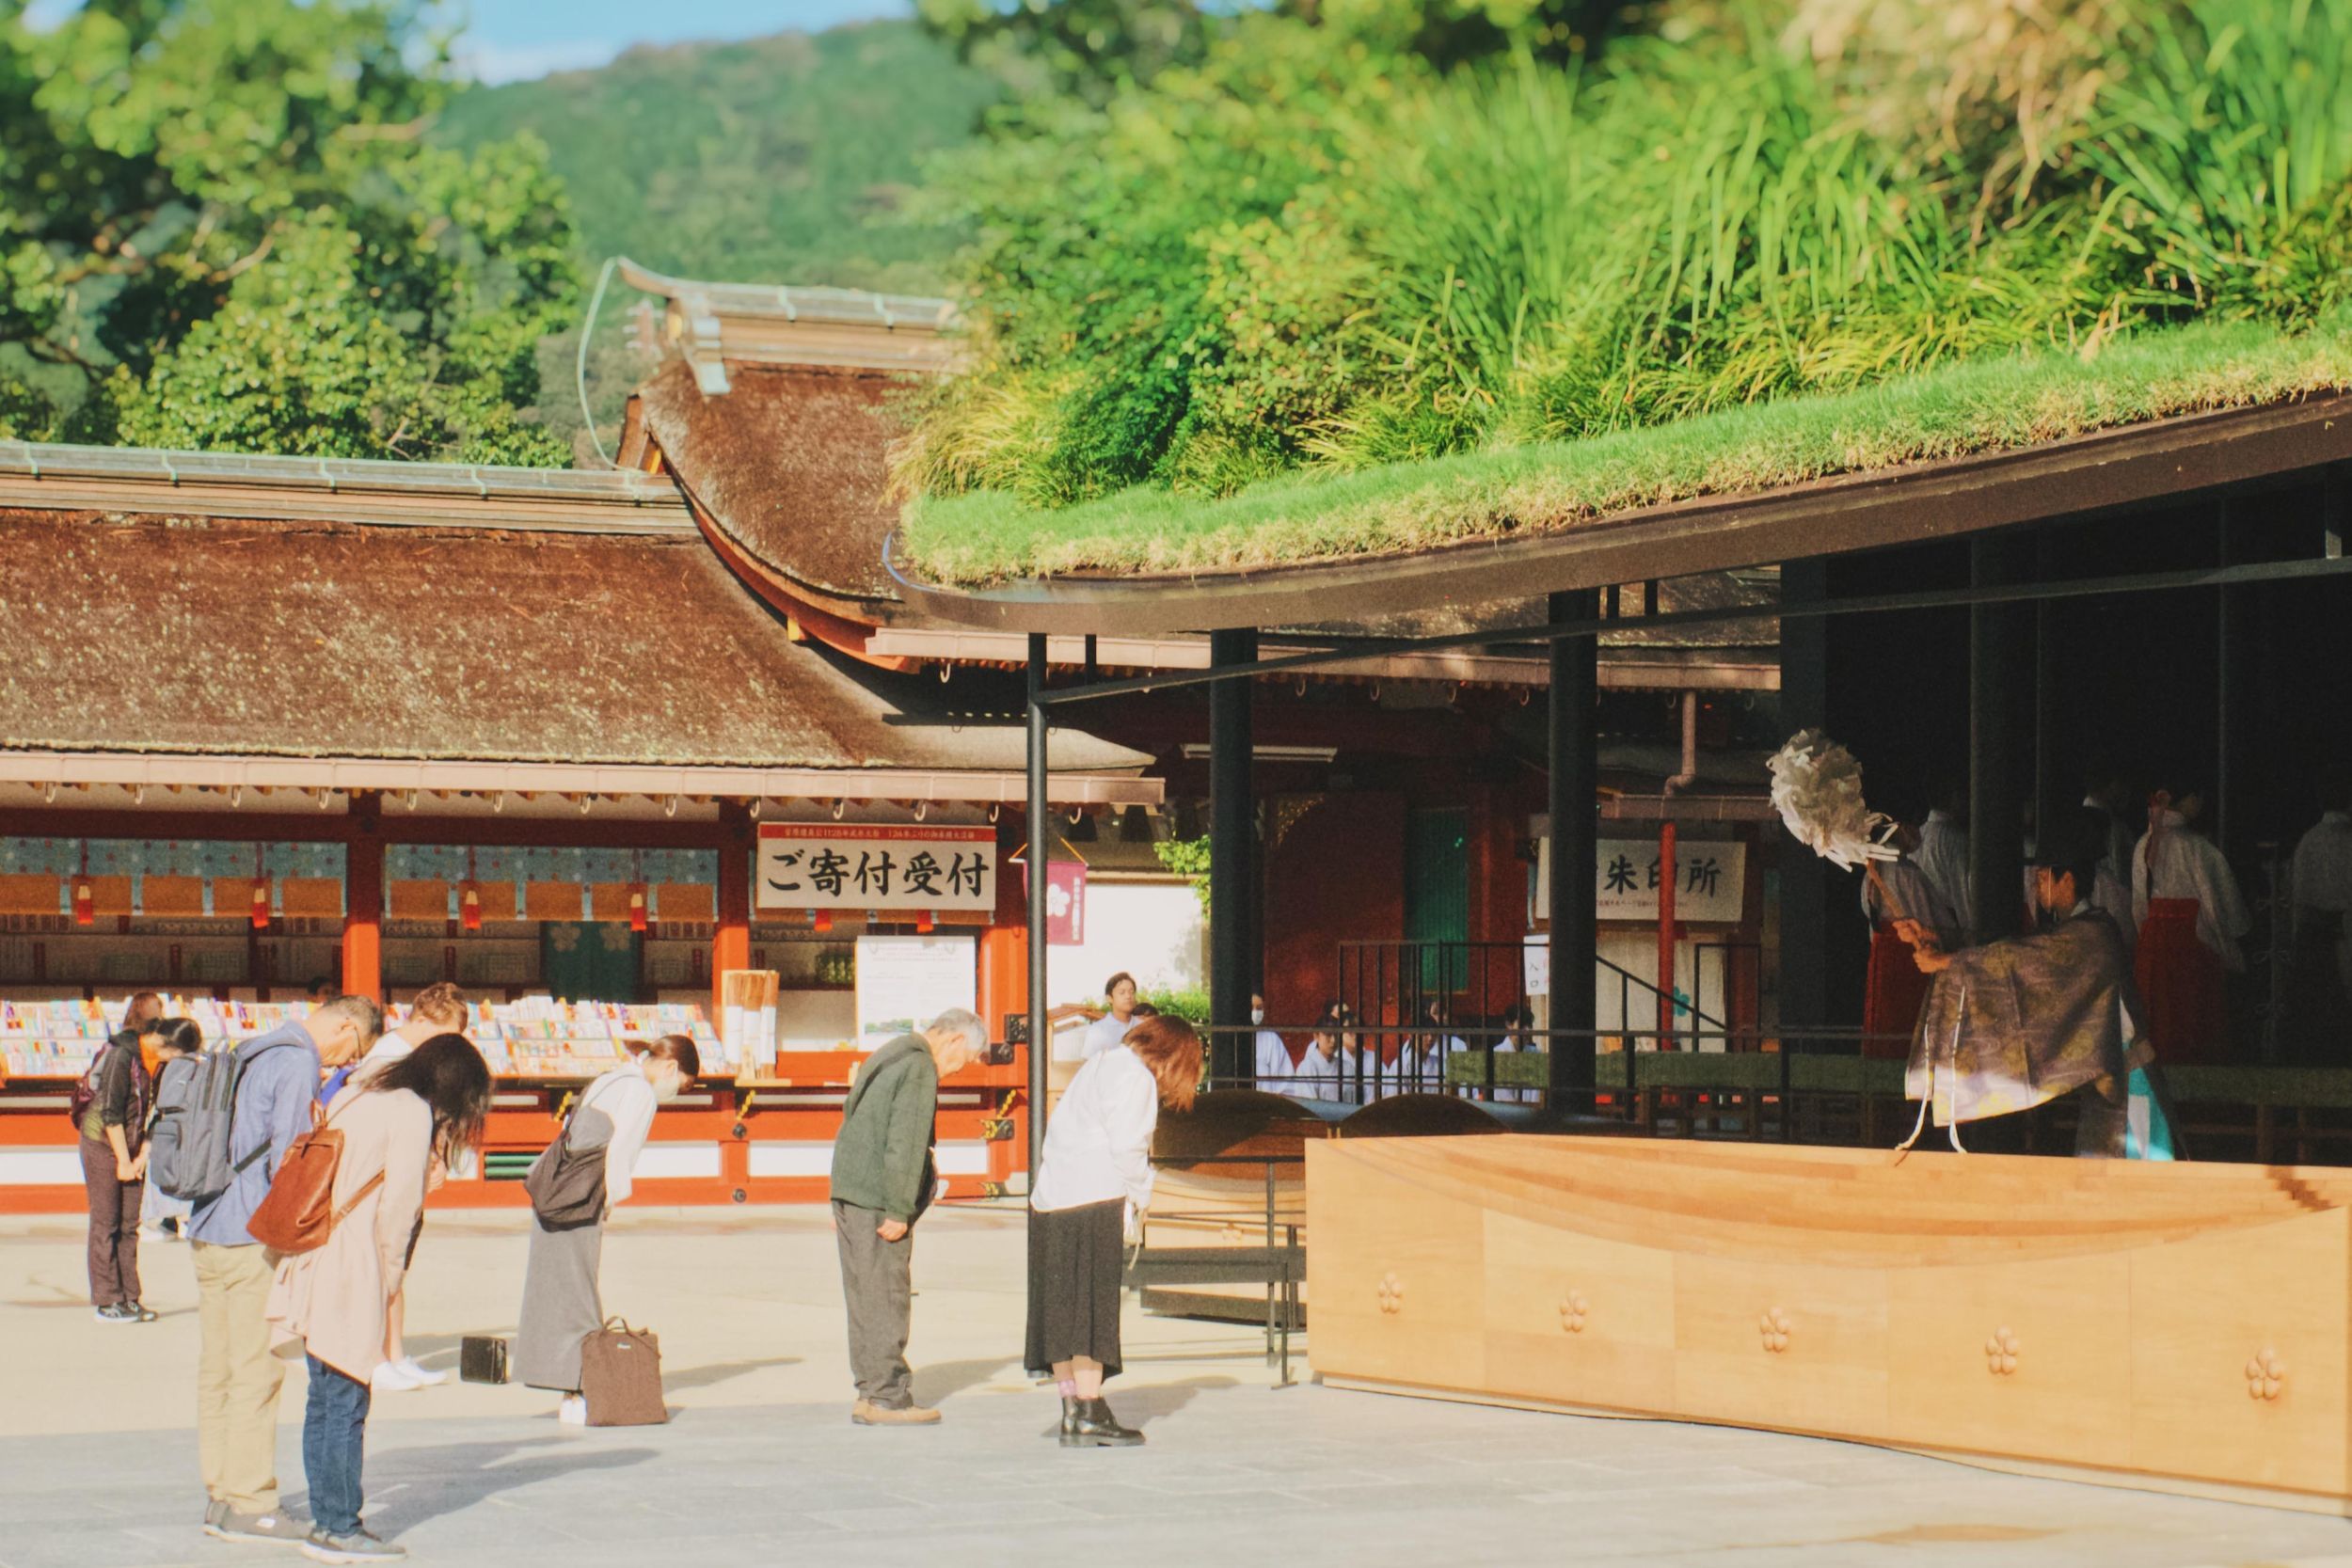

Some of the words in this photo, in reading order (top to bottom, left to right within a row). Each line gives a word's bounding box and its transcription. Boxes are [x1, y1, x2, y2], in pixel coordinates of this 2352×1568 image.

[768, 847, 990, 897] ご寄付受付
[1597, 853, 1722, 897] 朱印所
